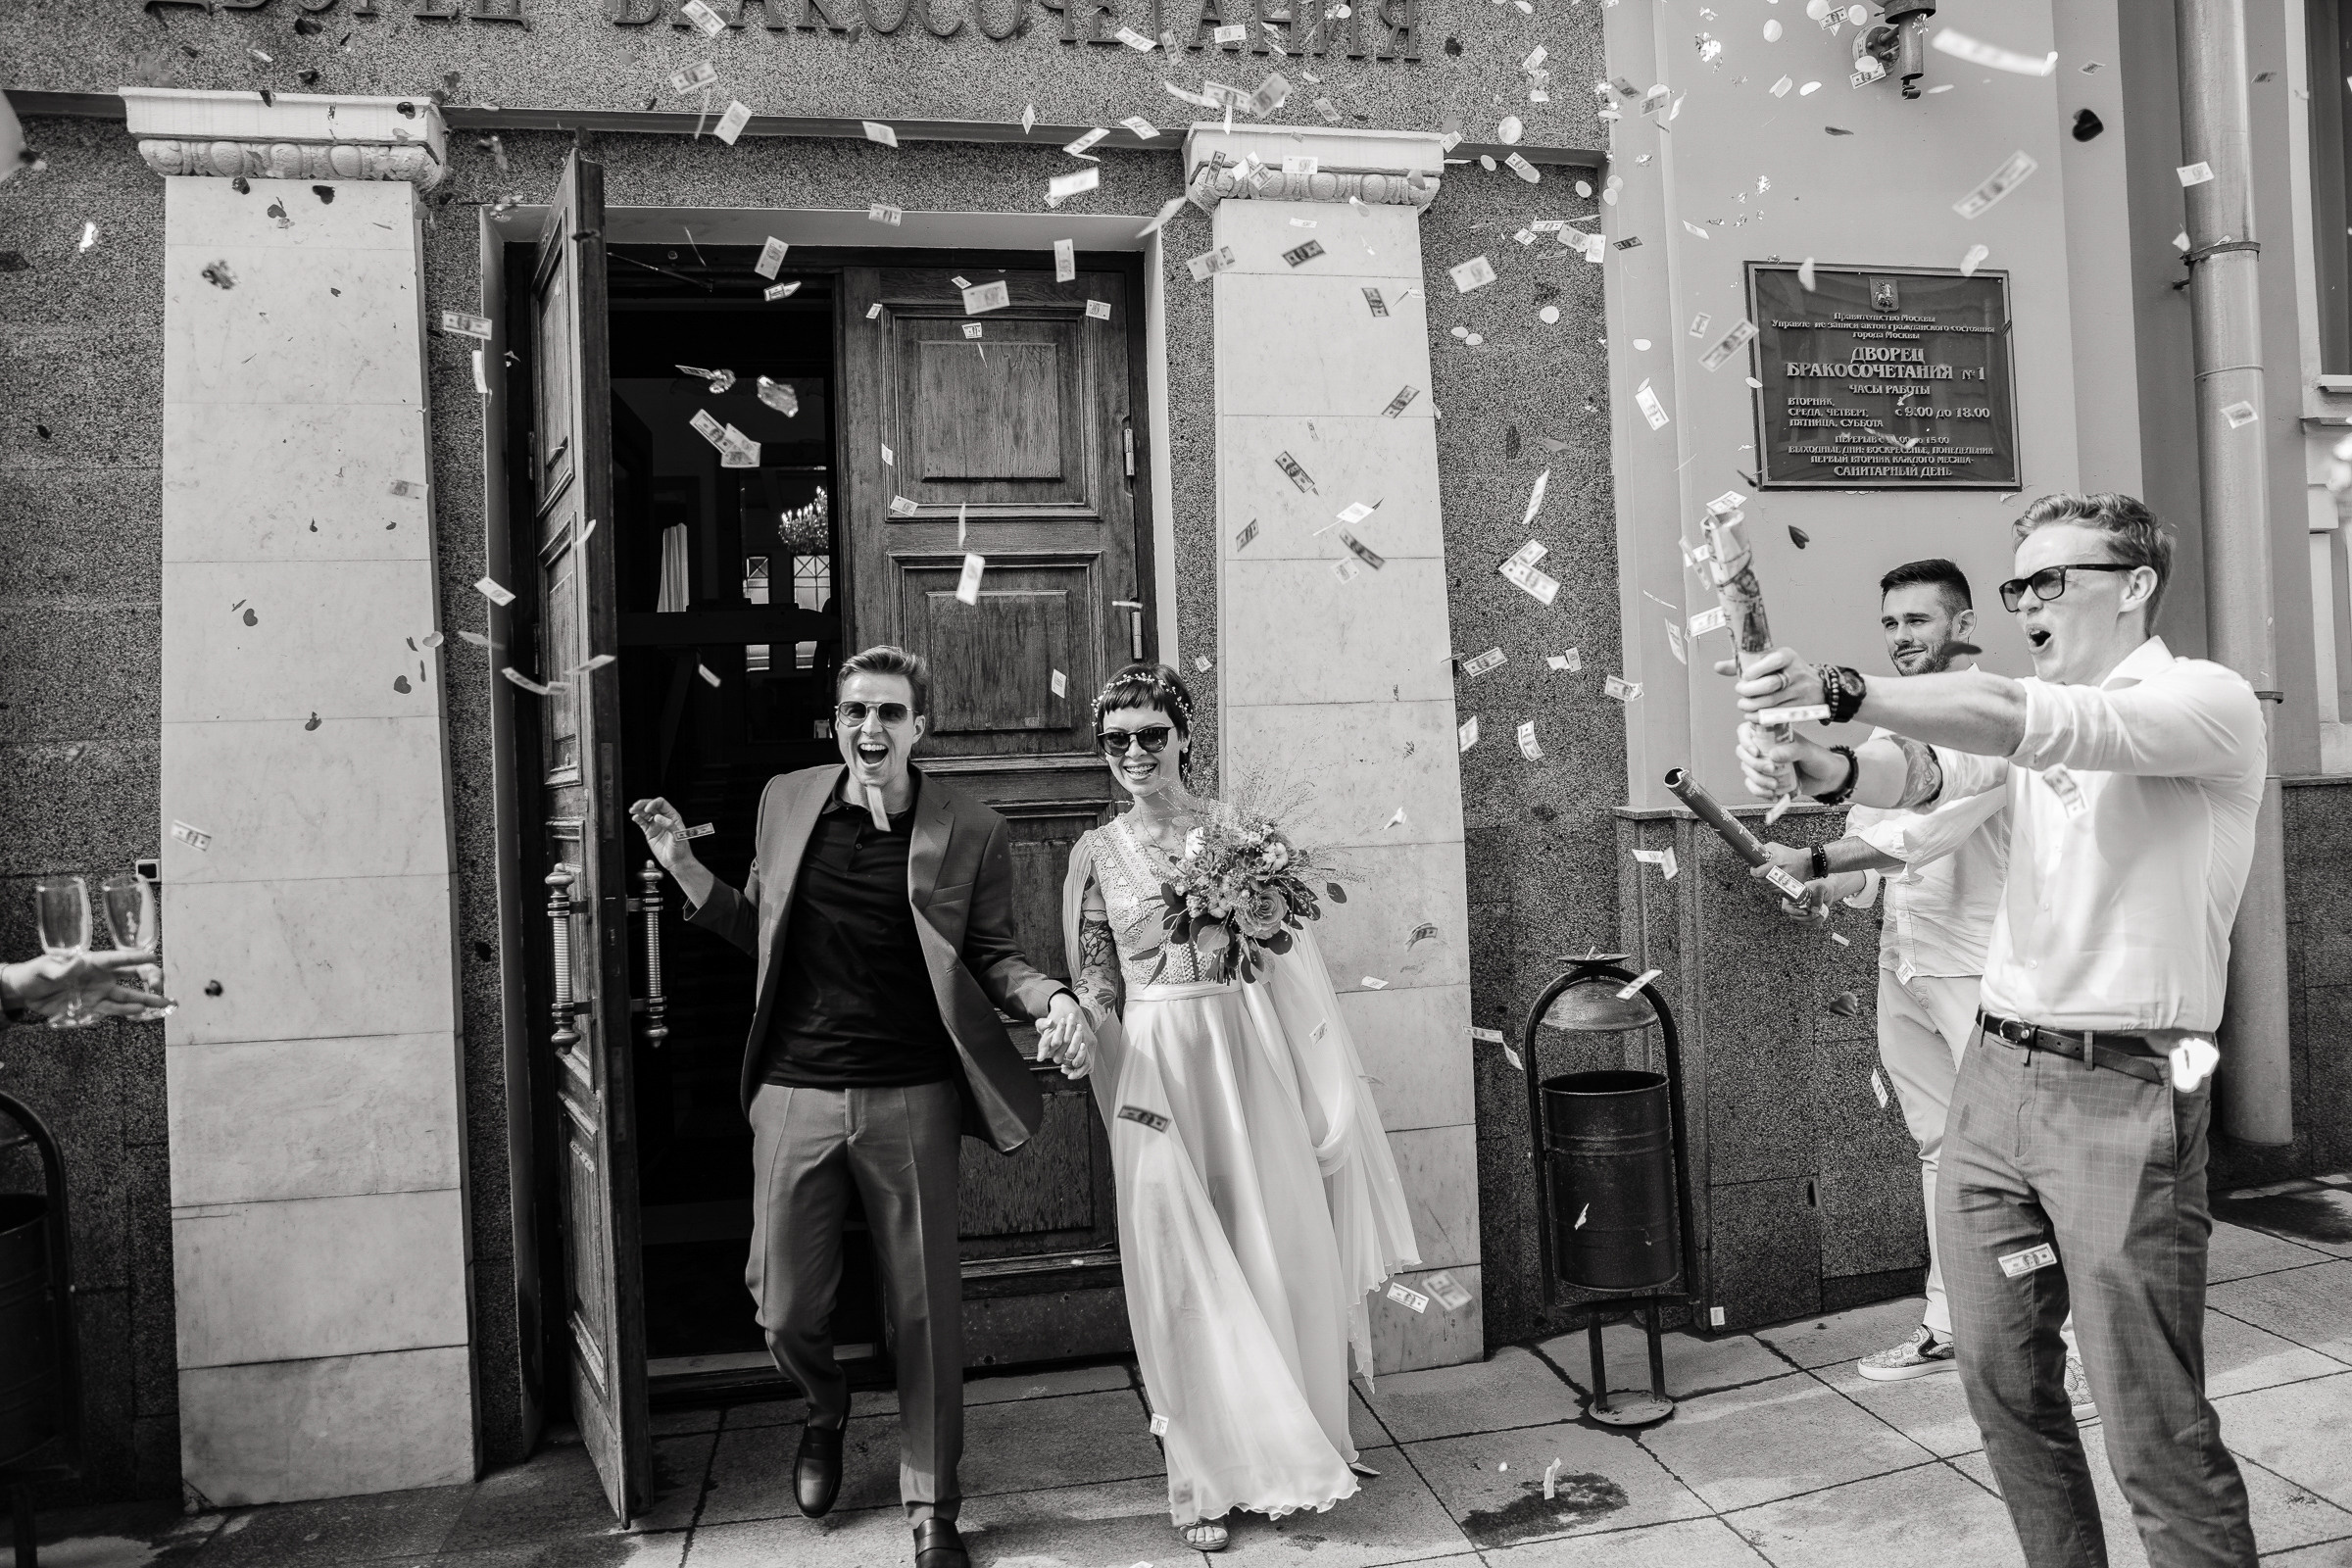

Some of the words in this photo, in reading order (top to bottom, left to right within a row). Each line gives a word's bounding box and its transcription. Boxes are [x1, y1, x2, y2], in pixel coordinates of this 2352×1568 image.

[1834, 313, 1900, 321] Правительство
[1901, 314, 1936, 322] Москвы
[1887, 322, 1949, 333] гражданского
[1950, 324, 1995, 333] состояния
[1885, 331, 1920, 340] Москвы
[1850, 346, 1926, 365] ДВОРЕЦ
[1785, 362, 1953, 379] БРАКОСОЧЕТАНИЯ
[1848, 384, 1883, 394] ЧАСЫ
[1886, 385, 1931, 395] РАБОТЫ
[1936, 409, 1952, 419] до
[1956, 407, 1990, 418] 18.00
[1839, 418, 1884, 428] СУББОТА
[1835, 435, 1878, 444] ПЕРЕРЫВ
[1788, 446, 1841, 455] ВЫХОДНЫЕ
[1842, 446, 1865, 455] ДНИ:
[1932, 446, 1994, 455] ПОНЕДЕЛЬНИК
[1810, 454, 1848, 464] ПЕРВЫЙ
[1891, 456, 1936, 465] КАЖДОГО
[1834, 465, 1919, 477] САНИТАРНЫЙ
[1920, 466, 1952, 478] ДЕНЬ
